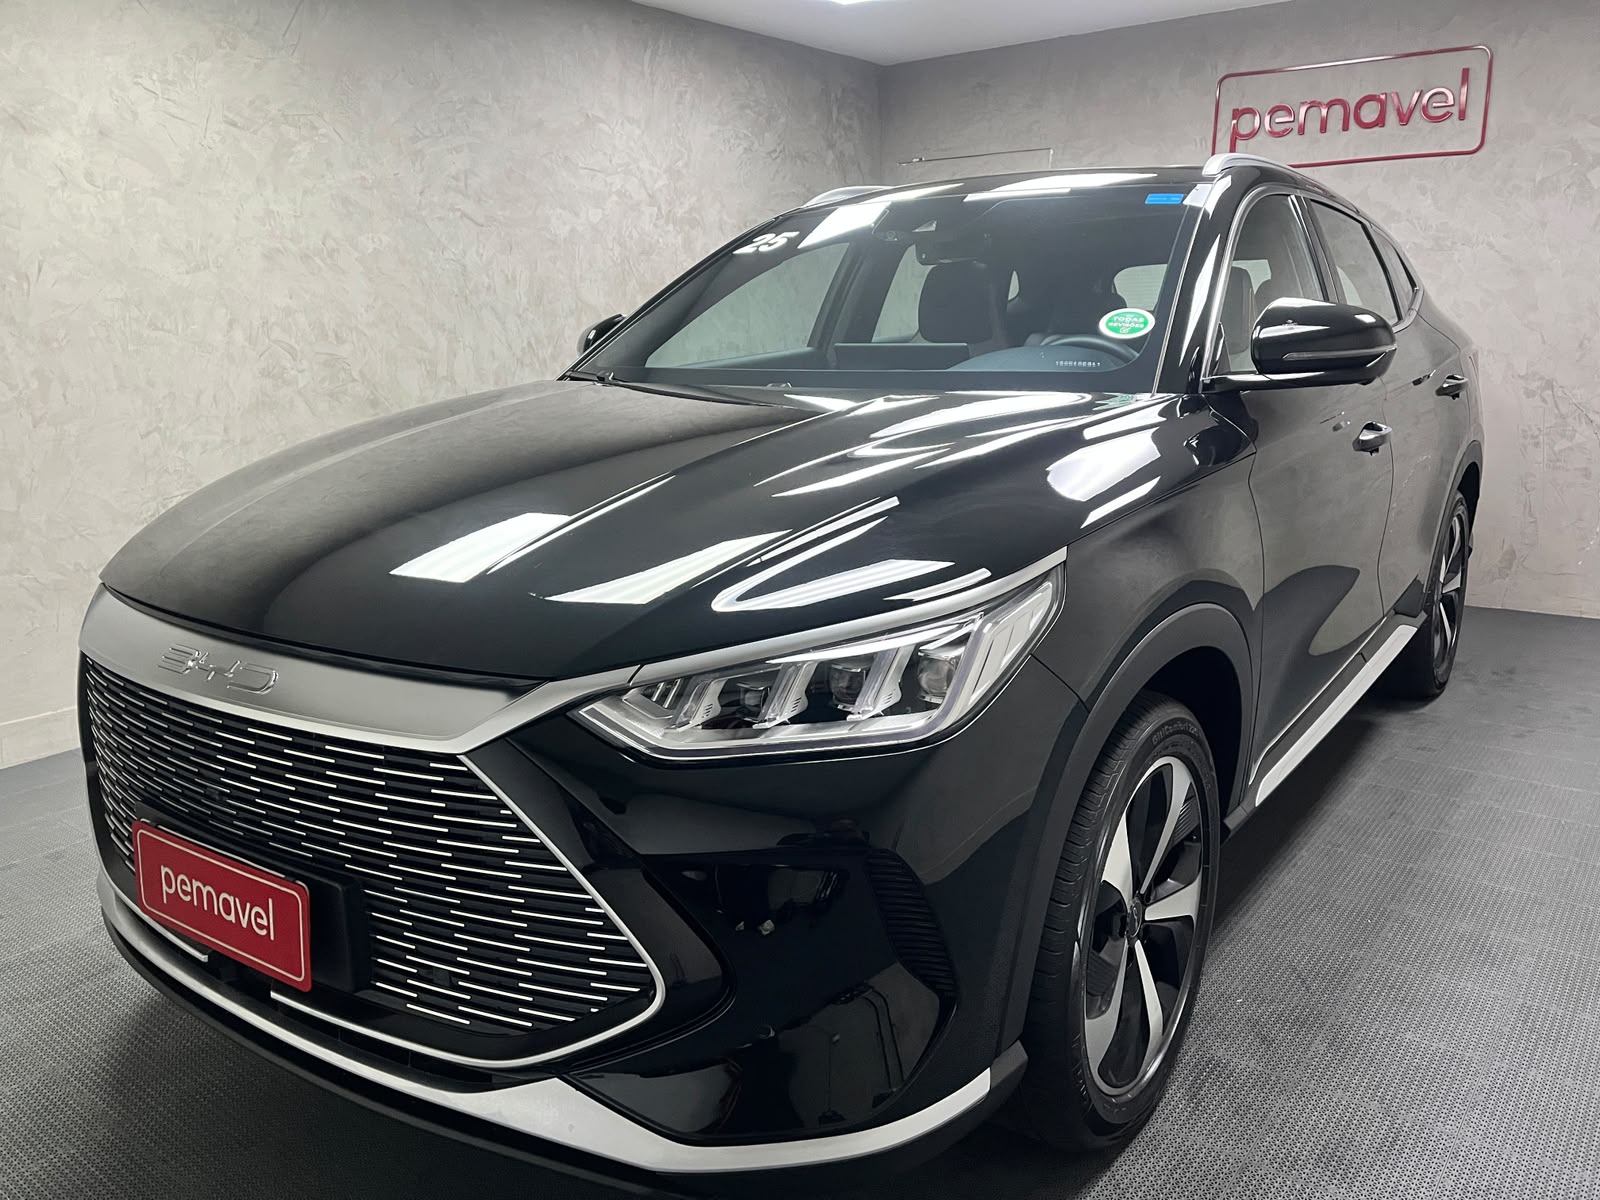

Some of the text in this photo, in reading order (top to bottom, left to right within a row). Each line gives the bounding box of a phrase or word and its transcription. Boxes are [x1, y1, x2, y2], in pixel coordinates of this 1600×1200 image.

[1229, 67, 1470, 153] pemavel
[732, 231, 800, 254] 25
[157, 642, 279, 695] BYD
[160, 864, 275, 941] pemavel
